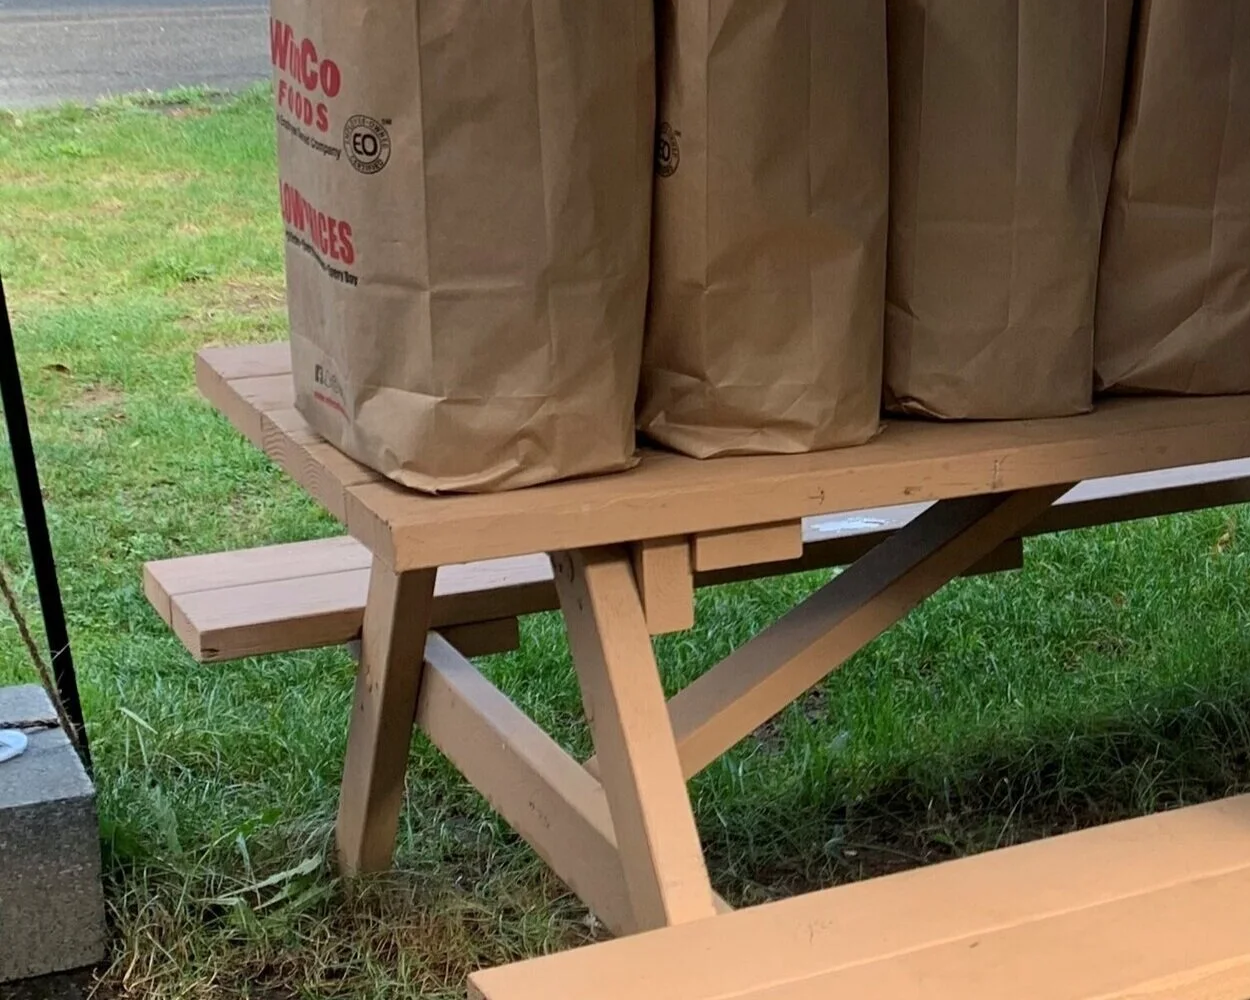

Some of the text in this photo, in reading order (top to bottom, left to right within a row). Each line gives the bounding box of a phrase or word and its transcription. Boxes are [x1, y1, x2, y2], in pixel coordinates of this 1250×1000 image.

[270, 16, 340, 98] WinCo
[278, 79, 329, 132] FOODS
[353, 133, 378, 156] EO
